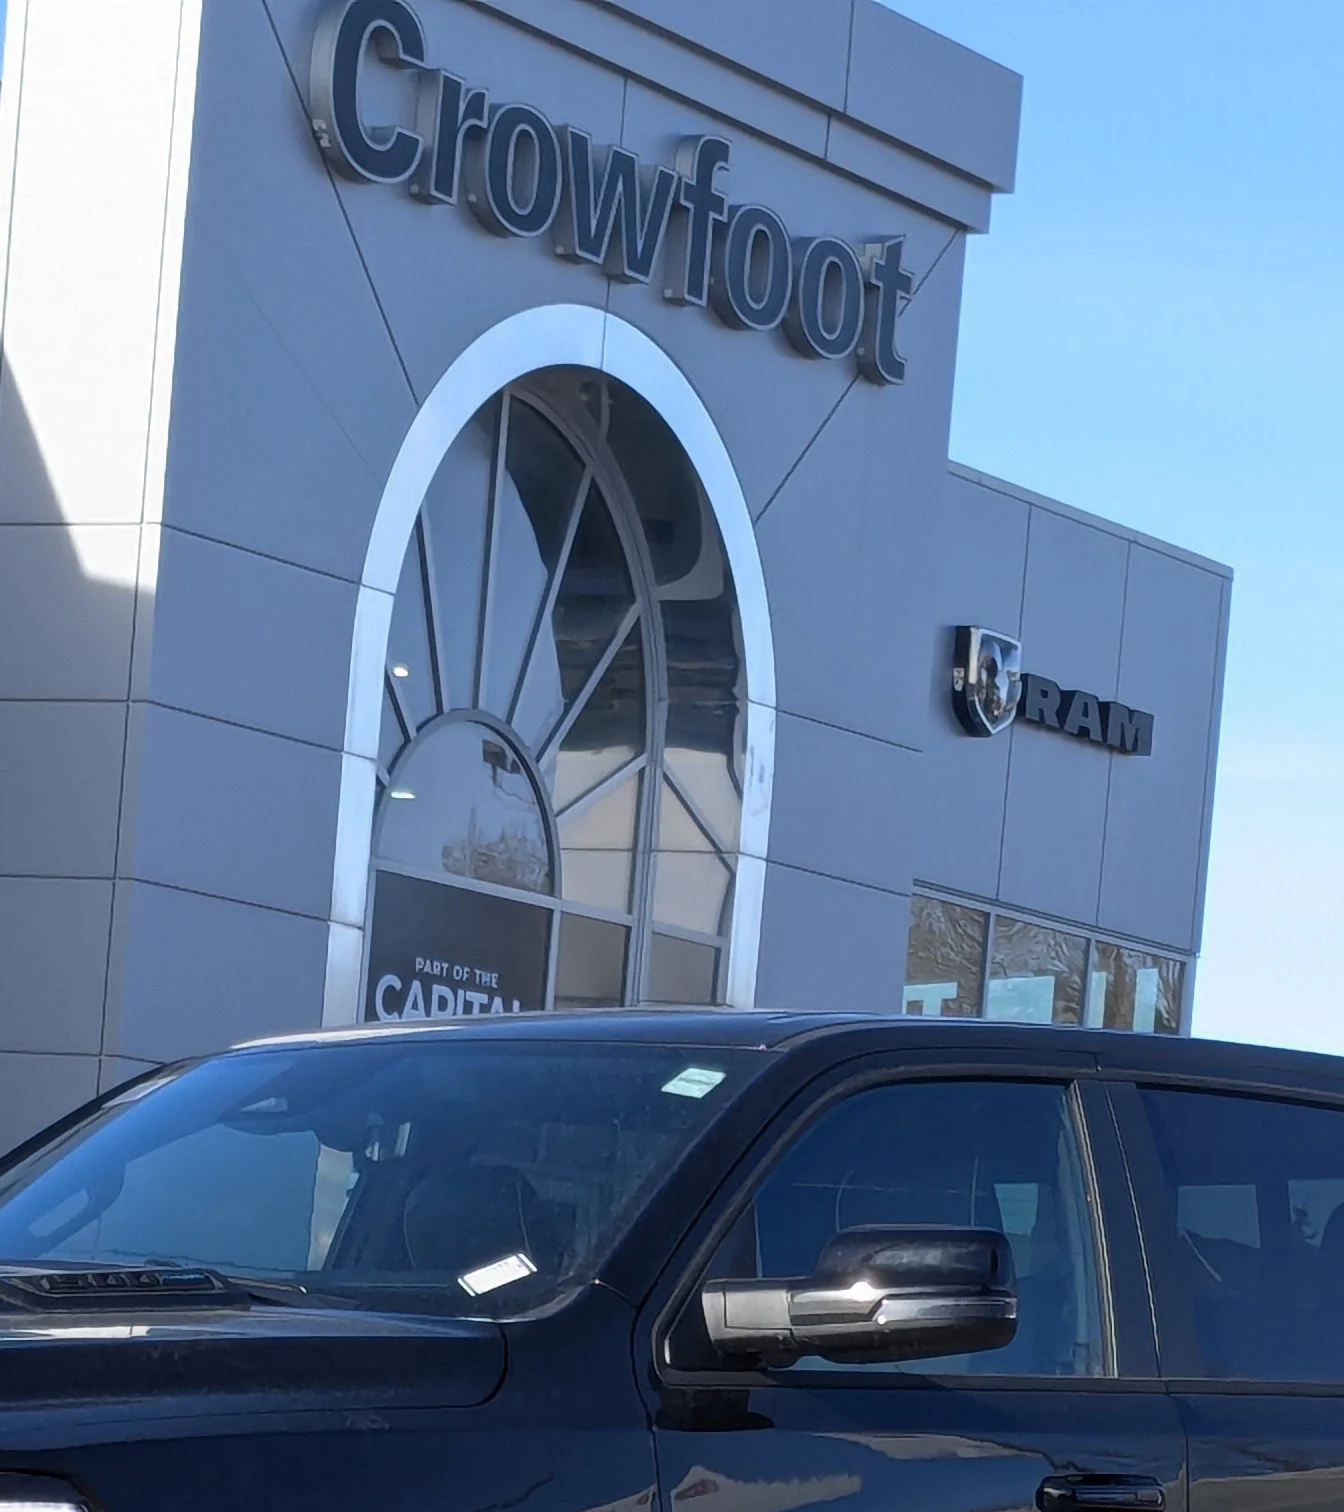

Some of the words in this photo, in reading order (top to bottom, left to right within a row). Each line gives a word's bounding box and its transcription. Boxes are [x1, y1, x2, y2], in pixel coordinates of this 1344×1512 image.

[311, 0, 914, 385] Crowfoot
[1021, 673, 1155, 756] RAM
[415, 956, 449, 979] PART
[453, 965, 470, 981] OF
[475, 968, 499, 989] THE
